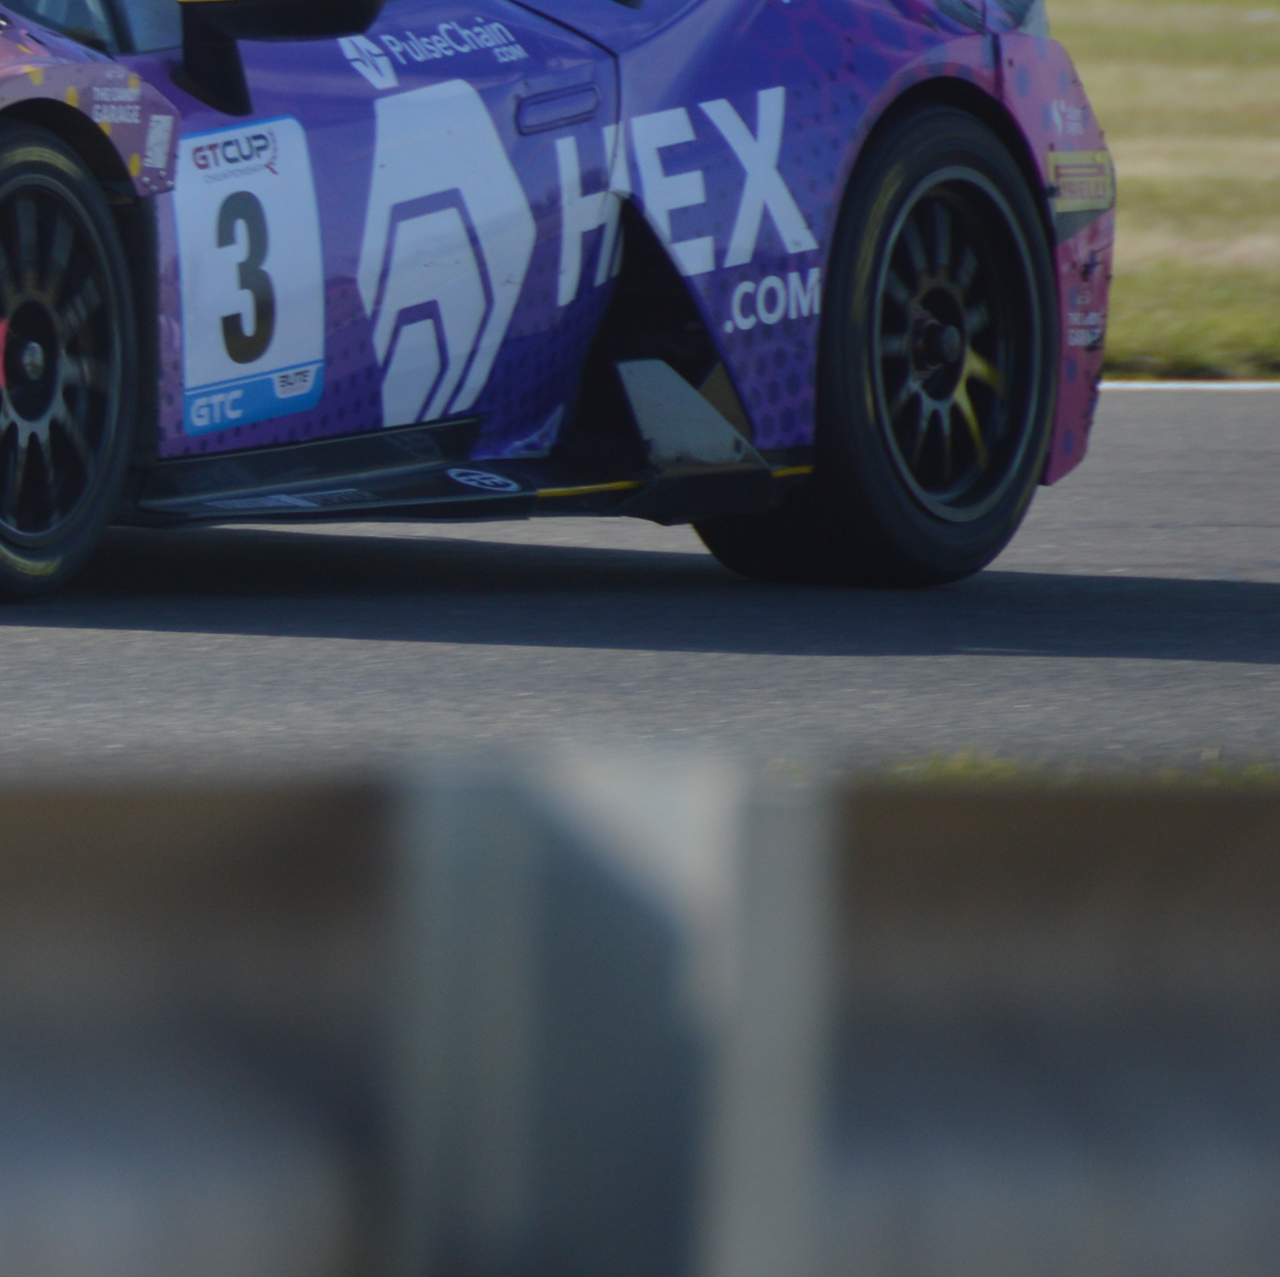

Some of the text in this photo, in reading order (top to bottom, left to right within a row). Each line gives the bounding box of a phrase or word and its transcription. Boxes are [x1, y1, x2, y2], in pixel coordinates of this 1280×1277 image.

[379, 16, 517, 65] PulseChain
[554, 85, 820, 308] HEX
[216, 190, 276, 365] 3
[723, 267, 821, 335] .COM
[191, 389, 244, 427] GTC
